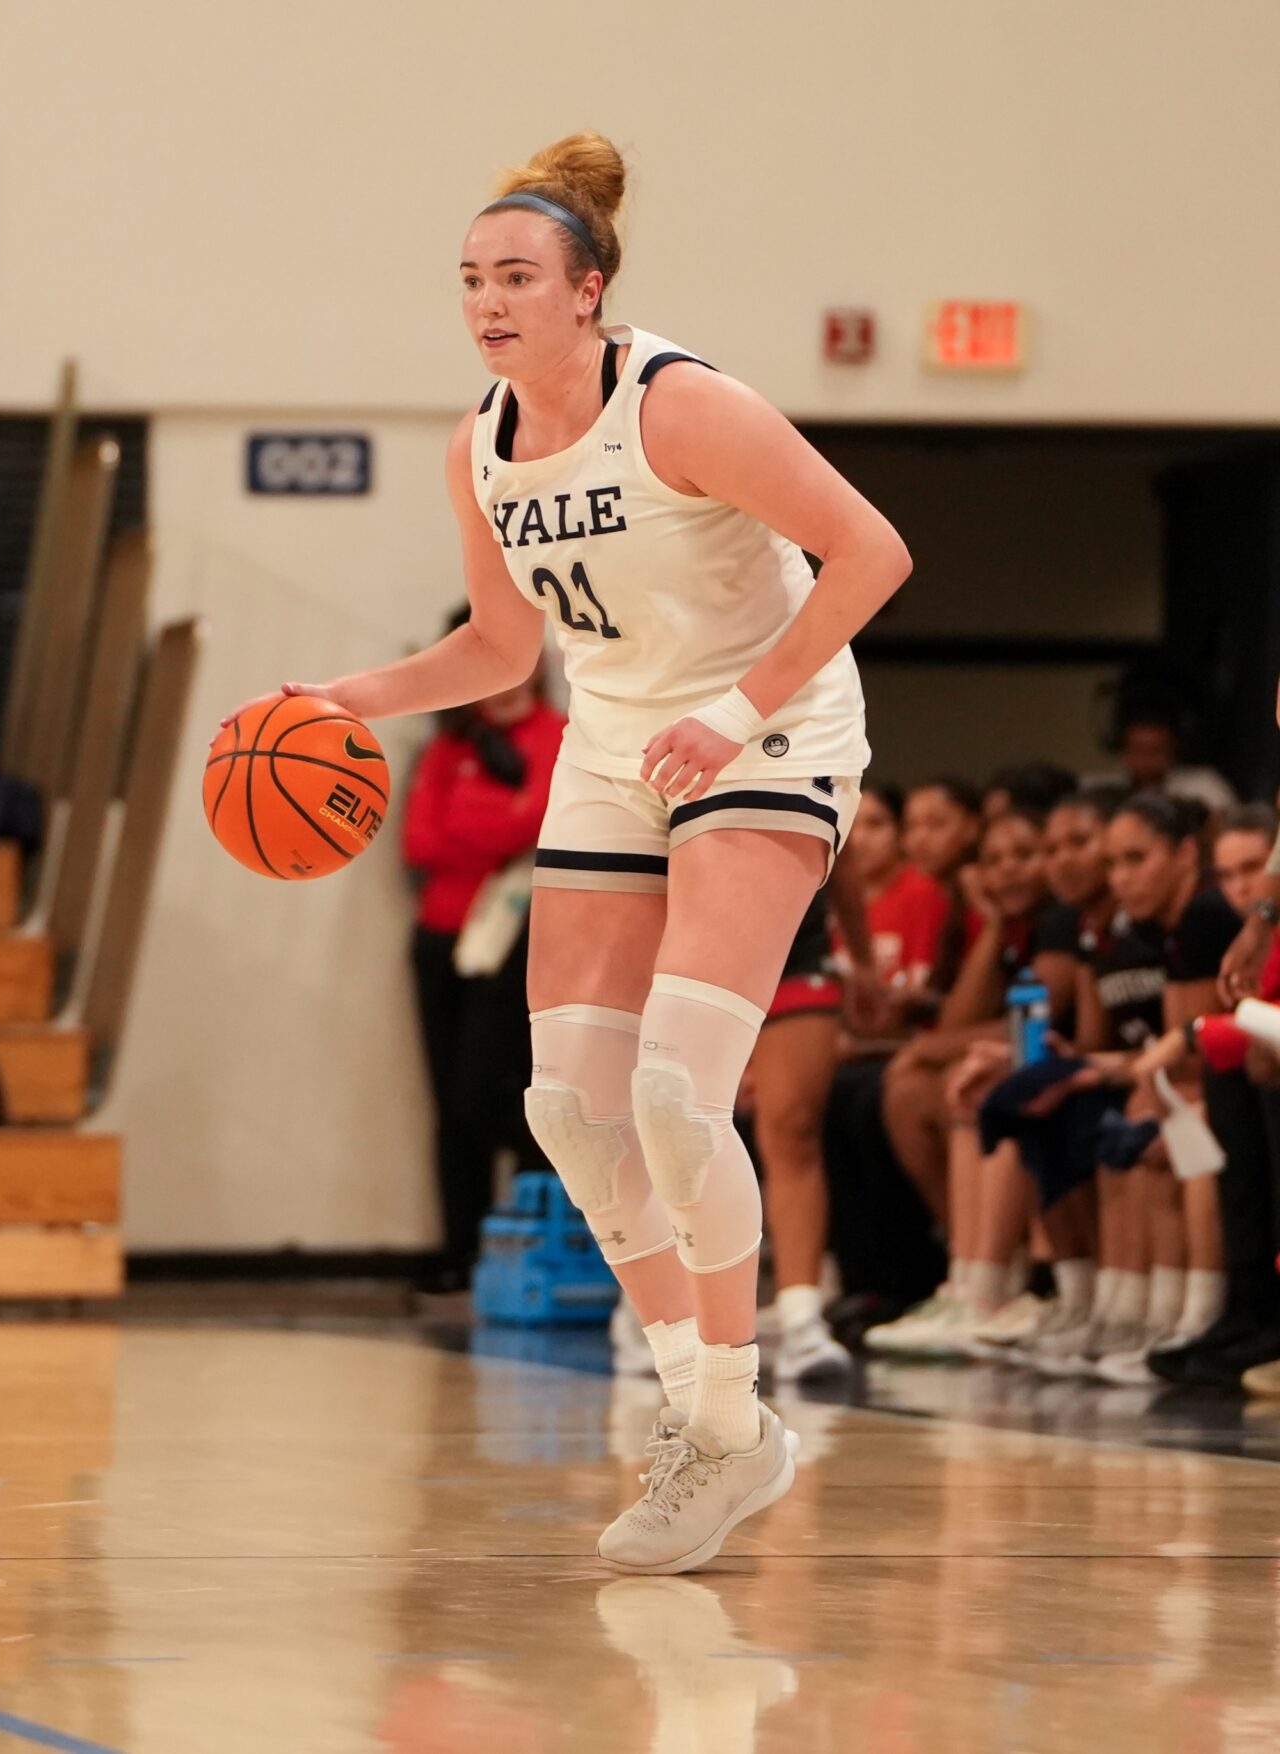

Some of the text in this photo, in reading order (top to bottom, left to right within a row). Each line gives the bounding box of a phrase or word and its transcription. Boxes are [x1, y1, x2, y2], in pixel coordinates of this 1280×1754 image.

[258, 438, 361, 491] 002
[493, 486, 627, 548] YALE
[532, 561, 622, 639] 21
[325, 783, 383, 840] ELITE
